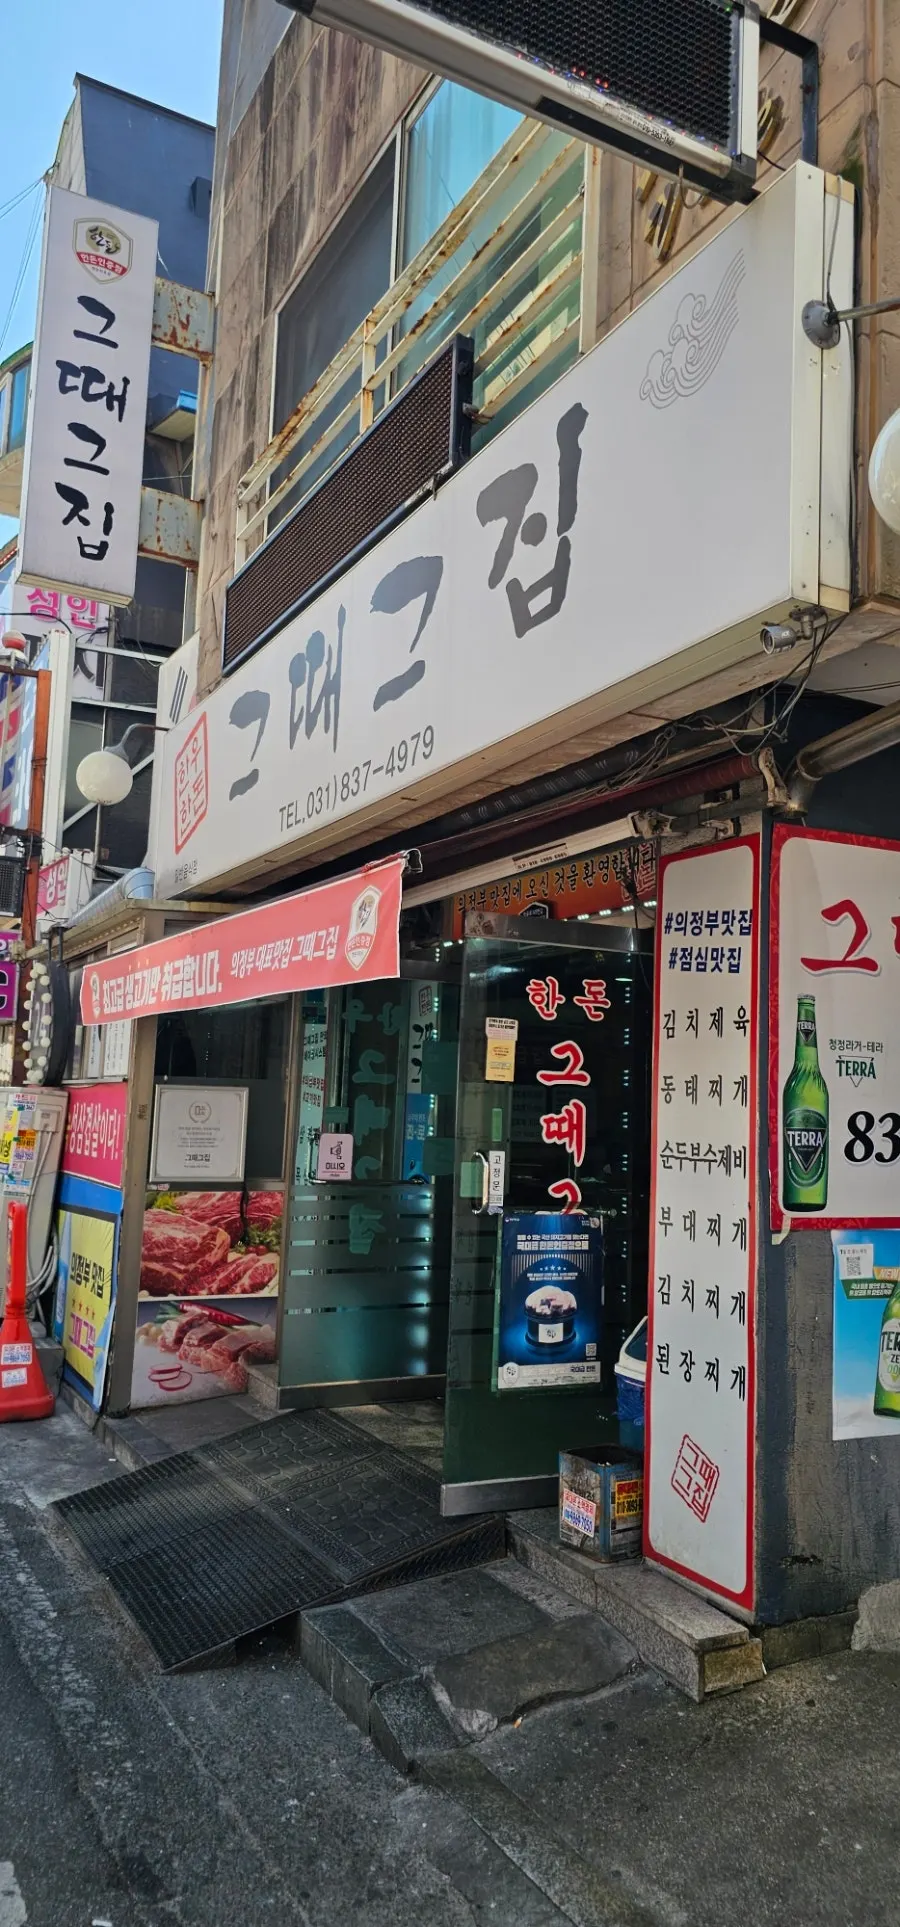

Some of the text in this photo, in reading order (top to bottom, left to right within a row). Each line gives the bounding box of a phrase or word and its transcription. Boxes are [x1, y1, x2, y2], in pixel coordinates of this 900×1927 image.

[55, 296, 130, 561] 그때그집
[27, 588, 98, 630] 성인
[229, 402, 589, 801] 그때그집
[458, 889, 488, 913] 의정부
[489, 883, 523, 909] 맛집에
[525, 871, 549, 900] 오신
[554, 864, 580, 897] 것을
[663, 908, 753, 937] #의정부맛집
[103, 926, 341, 1014] 최고급 생고기만 취급합니다. 의정부 대표맛집 그때그집
[668, 946, 742, 974] #점심맛집
[526, 975, 611, 1022] 한돈
[797, 1021, 816, 1031] TERRA
[828, 1038, 884, 1054] 청정라거-테라
[660, 1074, 748, 1108] 동태찌개
[834, 1059, 877, 1080] TERRA
[787, 1130, 824, 1148] TERRA
[843, 1110, 900, 1163] 83
[659, 1139, 747, 1180] 순두부수제비
[658, 1205, 748, 1253] 부대찌개
[657, 1274, 746, 1326] 김치찌개
[655, 1342, 747, 1402] 된장찌개
